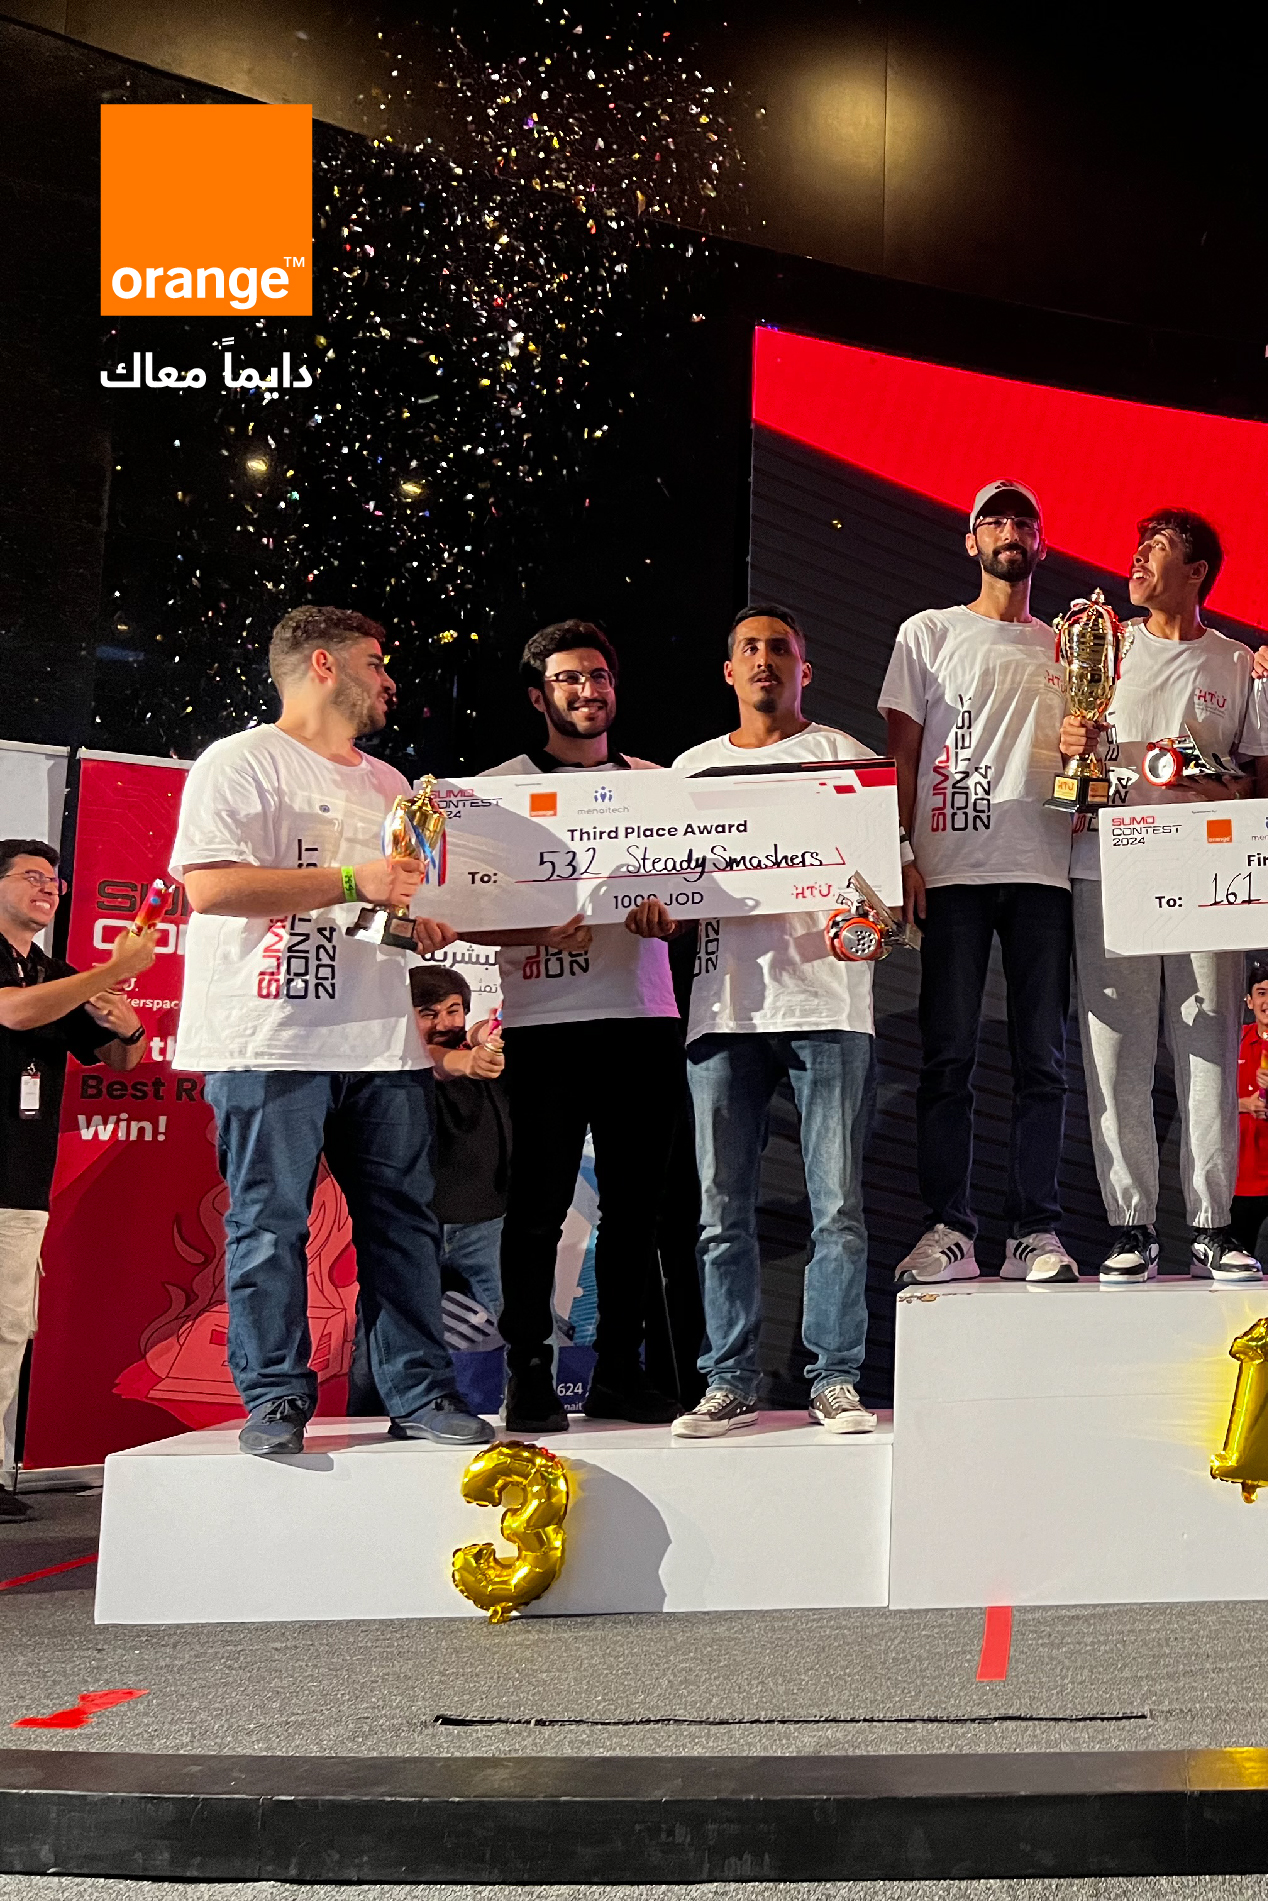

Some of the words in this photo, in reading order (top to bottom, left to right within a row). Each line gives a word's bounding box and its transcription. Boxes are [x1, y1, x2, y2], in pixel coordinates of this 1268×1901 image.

[1196, 689, 1227, 709] HTU
[437, 797, 503, 809] ONTEST
[973, 764, 992, 832] 2024
[566, 828, 619, 842] Third
[624, 823, 678, 839] Place
[684, 819, 748, 837] Award
[1111, 815, 1155, 827] SUMO
[1111, 824, 1182, 837] CONTEST
[1112, 837, 1145, 847] 2024
[532, 847, 602, 882] 532
[467, 871, 499, 885] To:
[1209, 871, 1262, 906] 161
[664, 891, 704, 906] JOD
[1155, 895, 1183, 909] To:
[704, 917, 721, 974] 202
[314, 926, 337, 1000] 2024
[80, 1074, 166, 1101] Best
[77, 1112, 168, 1142] Win!
[452, 1440, 570, 1624] 3
